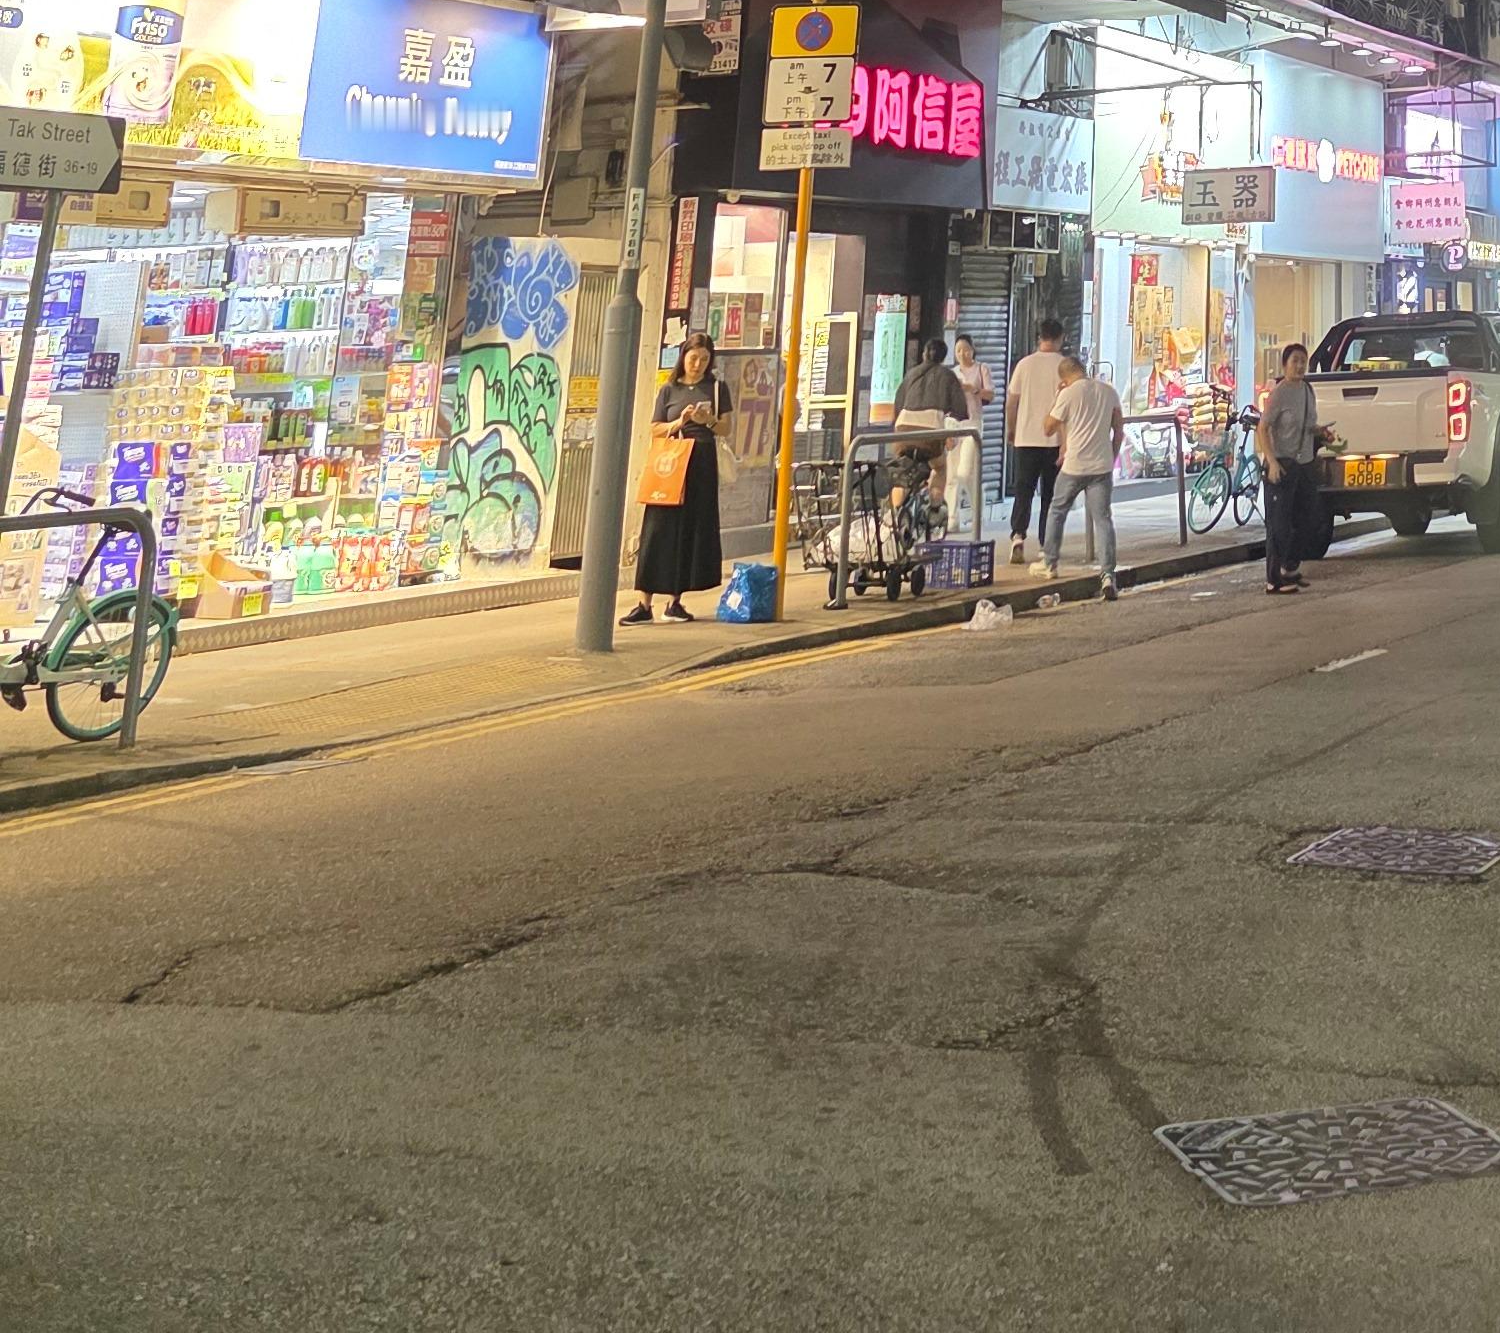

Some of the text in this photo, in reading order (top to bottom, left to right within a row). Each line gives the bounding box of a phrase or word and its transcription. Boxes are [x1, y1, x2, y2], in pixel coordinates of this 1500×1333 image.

[398, 28, 476, 88] 嘉盈
[783, 73, 809, 85] 上午
[789, 62, 837, 83] am 7
[782, 106, 807, 119] 下午
[786, 96, 835, 117] pm 7
[8, 118, 91, 144] Tak Street
[782, 130, 831, 142] Except taxi
[771, 141, 789, 152] pick
[827, 141, 842, 151] off
[1188, 174, 1260, 209] 玉器
[1347, 473, 1383, 487] 3088
